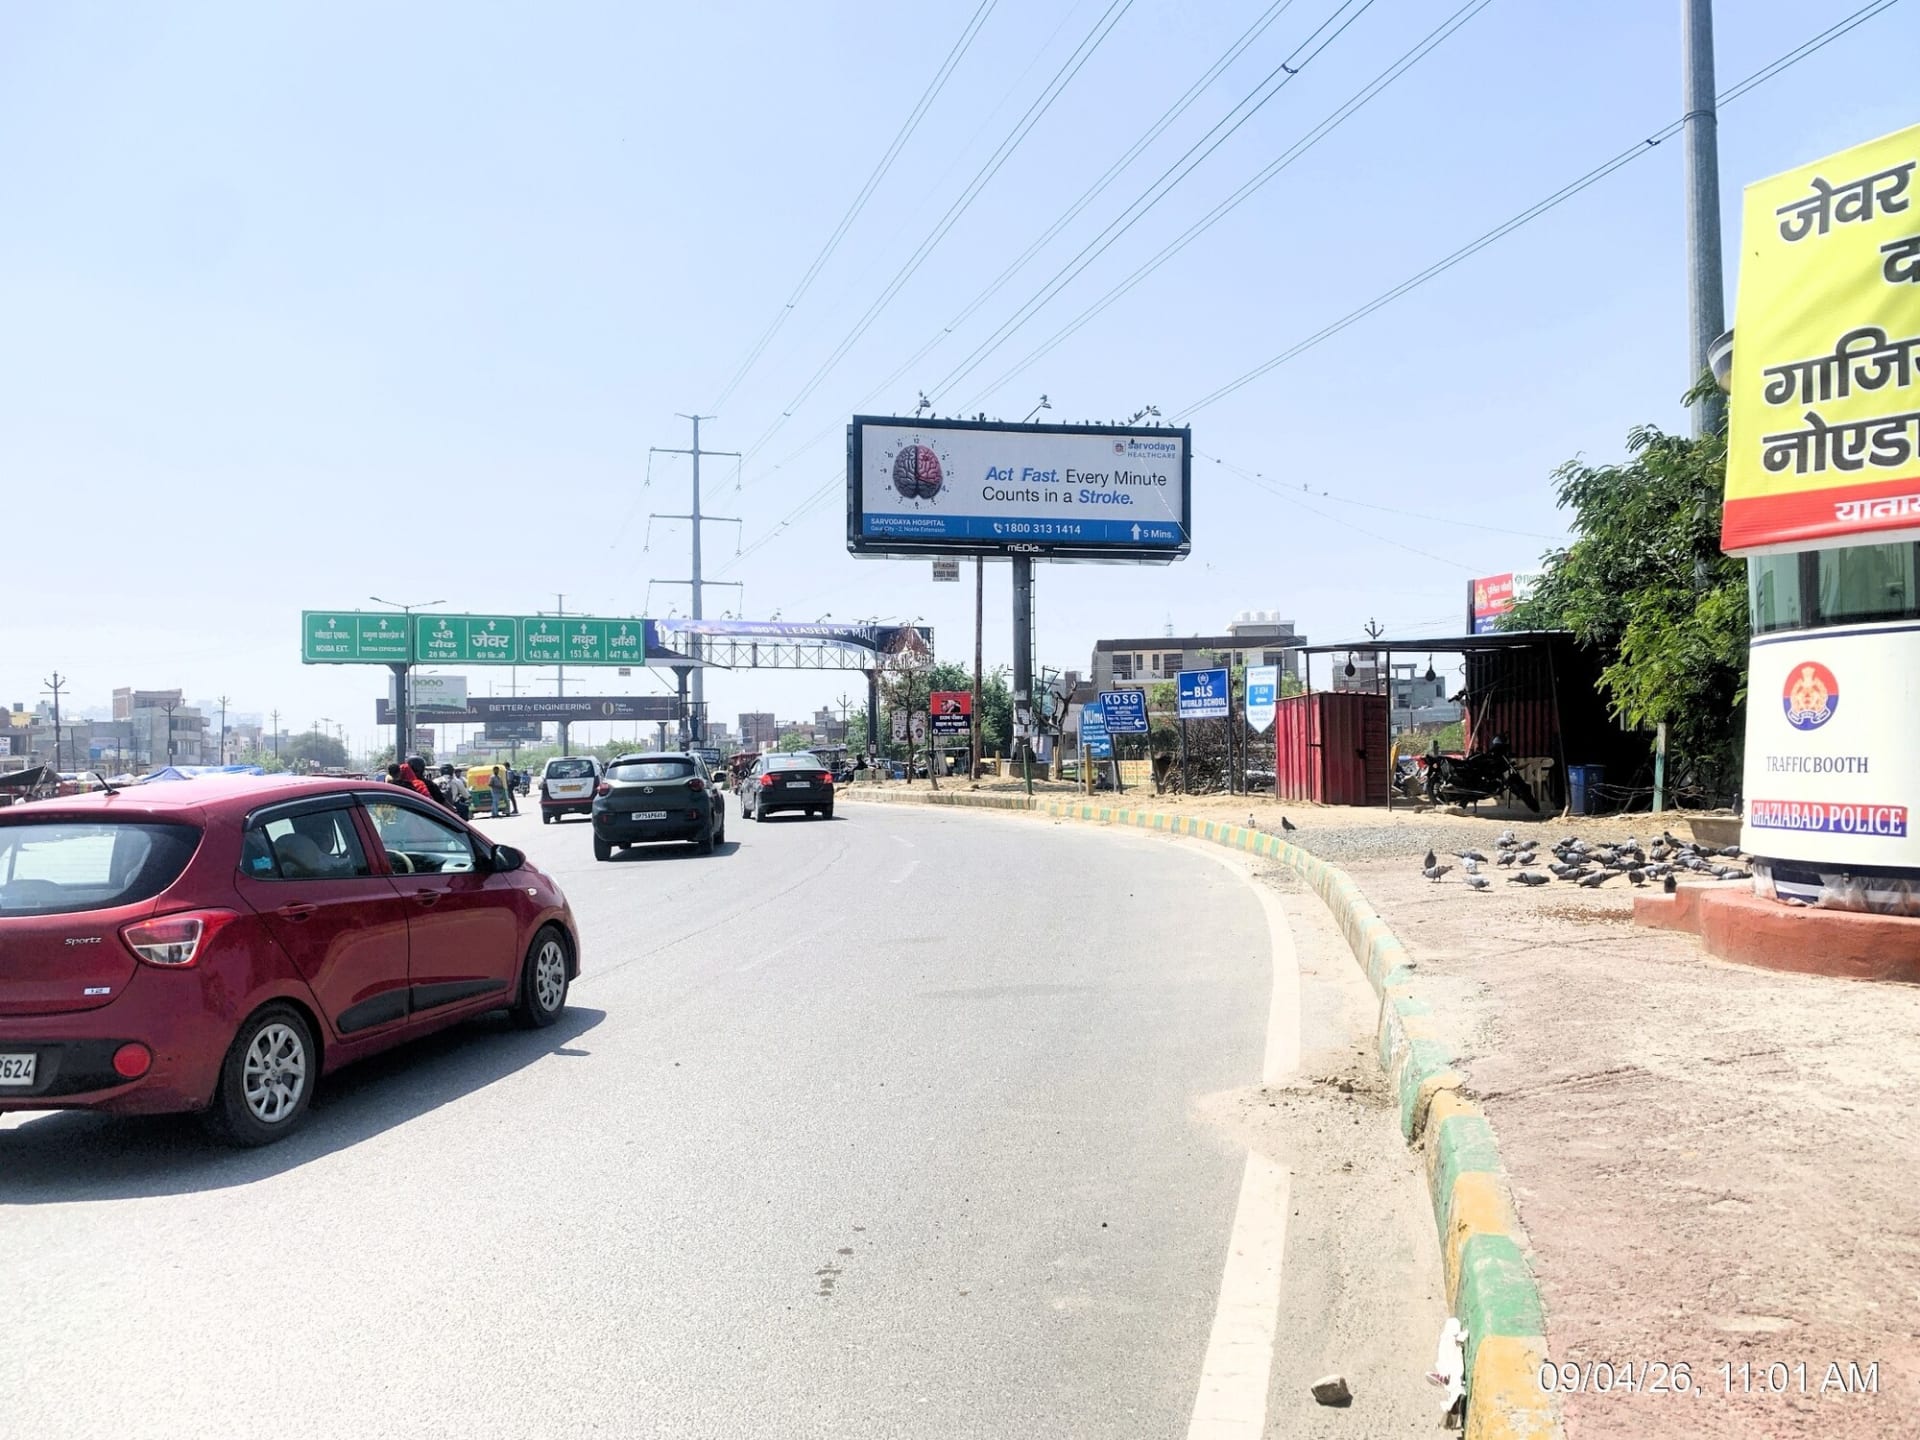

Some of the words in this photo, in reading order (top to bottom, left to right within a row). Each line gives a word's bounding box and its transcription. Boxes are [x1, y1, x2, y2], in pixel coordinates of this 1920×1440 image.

[1776, 161, 1916, 241] जेवर
[1763, 327, 1920, 404] गाजि
[985, 466, 1014, 481] Act
[1022, 467, 1060, 483] Fast.
[1066, 469, 1109, 488] Every
[1114, 470, 1167, 486] Minute
[982, 486, 1040, 502] Counts
[1045, 488, 1058, 503] in
[1063, 491, 1072, 503] a
[1078, 489, 1134, 505] Stroke.
[871, 518, 911, 526] SARVODAYA
[912, 519, 945, 527] HOSPITAL
[1004, 523, 1030, 533] 1800
[1033, 524, 1052, 534] 313
[1055, 524, 1081, 535] 1414
[1151, 530, 1175, 539] Mins.
[785, 626, 830, 635] LEASED
[471, 630, 510, 648] जेवर
[572, 634, 598, 650] मथुरा
[1194, 685, 1213, 697] BLS
[1104, 694, 1138, 705] KDSG
[1181, 699, 1203, 708] WORLD
[1203, 698, 1226, 706] SCHOOL
[489, 703, 523, 712] BETTER
[533, 703, 592, 711] ENGINEERING
[1813, 757, 1869, 773] BOOTH
[1752, 801, 1824, 830] GHAZIABAD
[1829, 805, 1903, 834] POLICE
